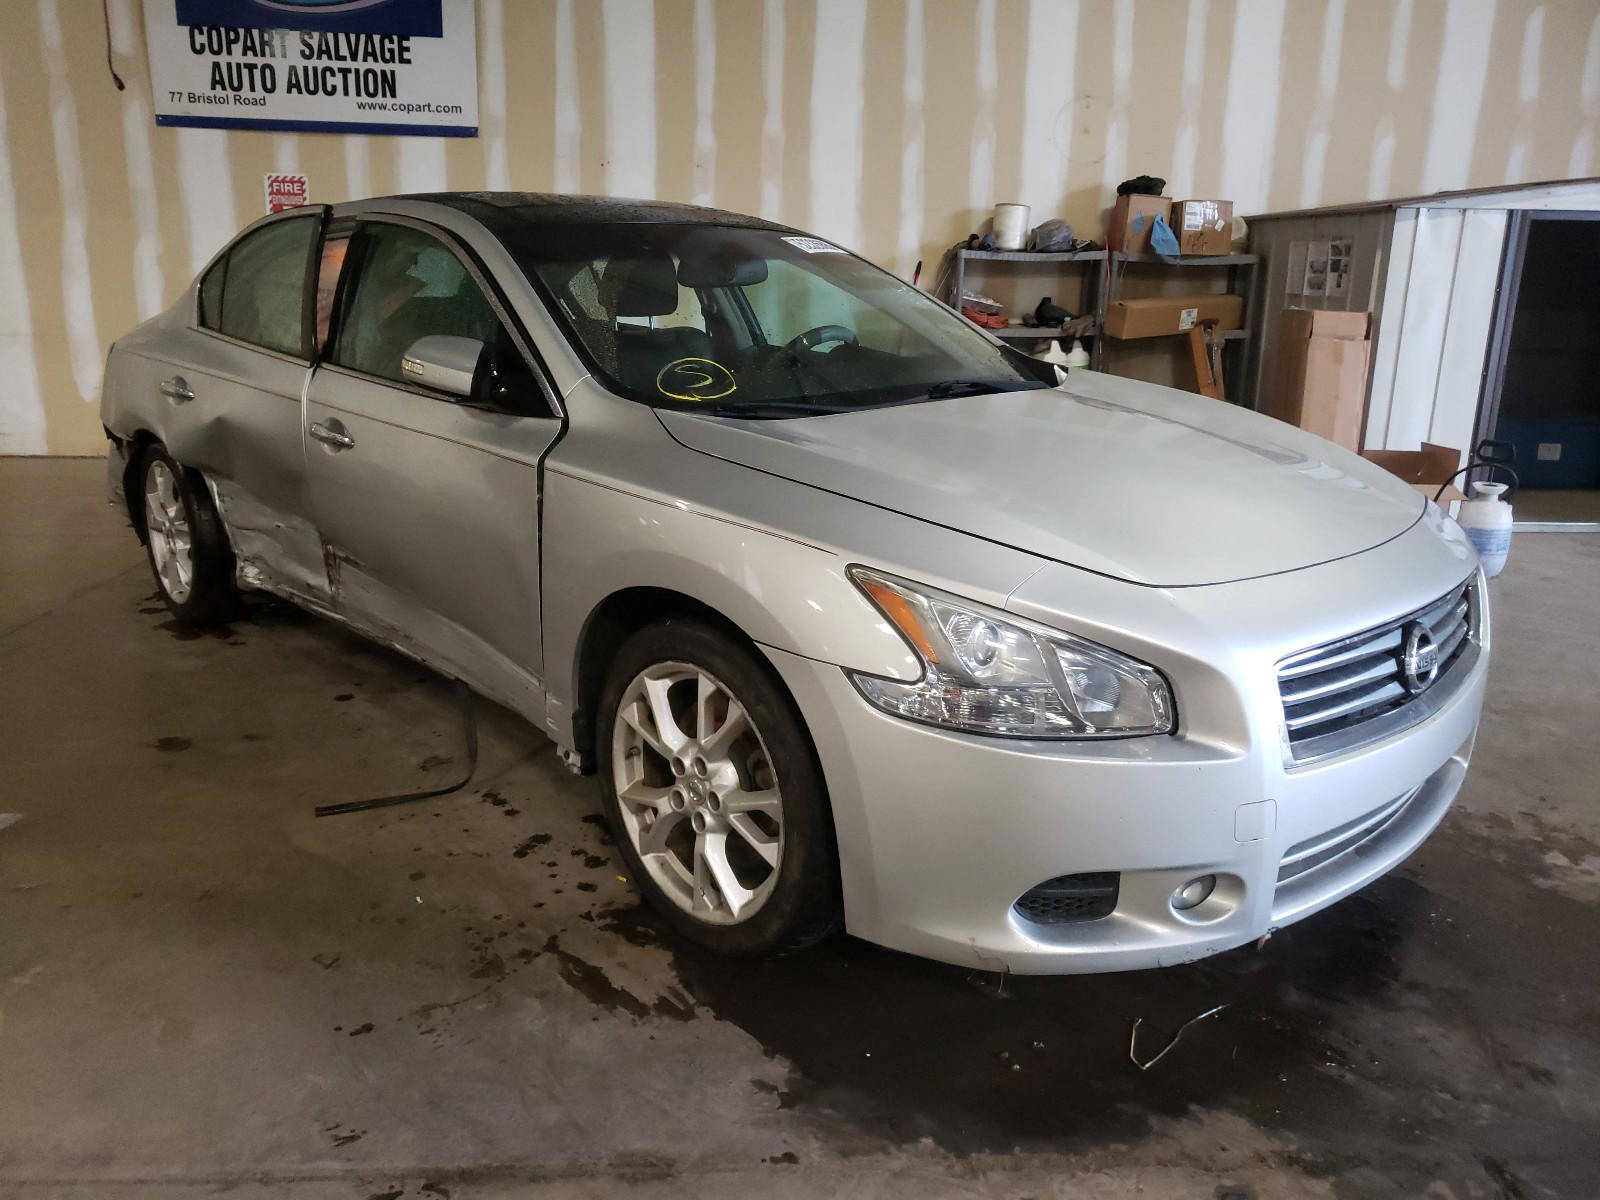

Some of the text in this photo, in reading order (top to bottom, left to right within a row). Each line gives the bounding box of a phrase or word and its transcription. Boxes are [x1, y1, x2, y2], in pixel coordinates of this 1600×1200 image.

[189, 26, 412, 64] COPART SALVAGE
[210, 61, 397, 98] AUTO AUCTION
[169, 91, 267, 106] 77 Bristol Road
[357, 101, 462, 114] www.copart.com
[272, 182, 303, 194] FIRE
